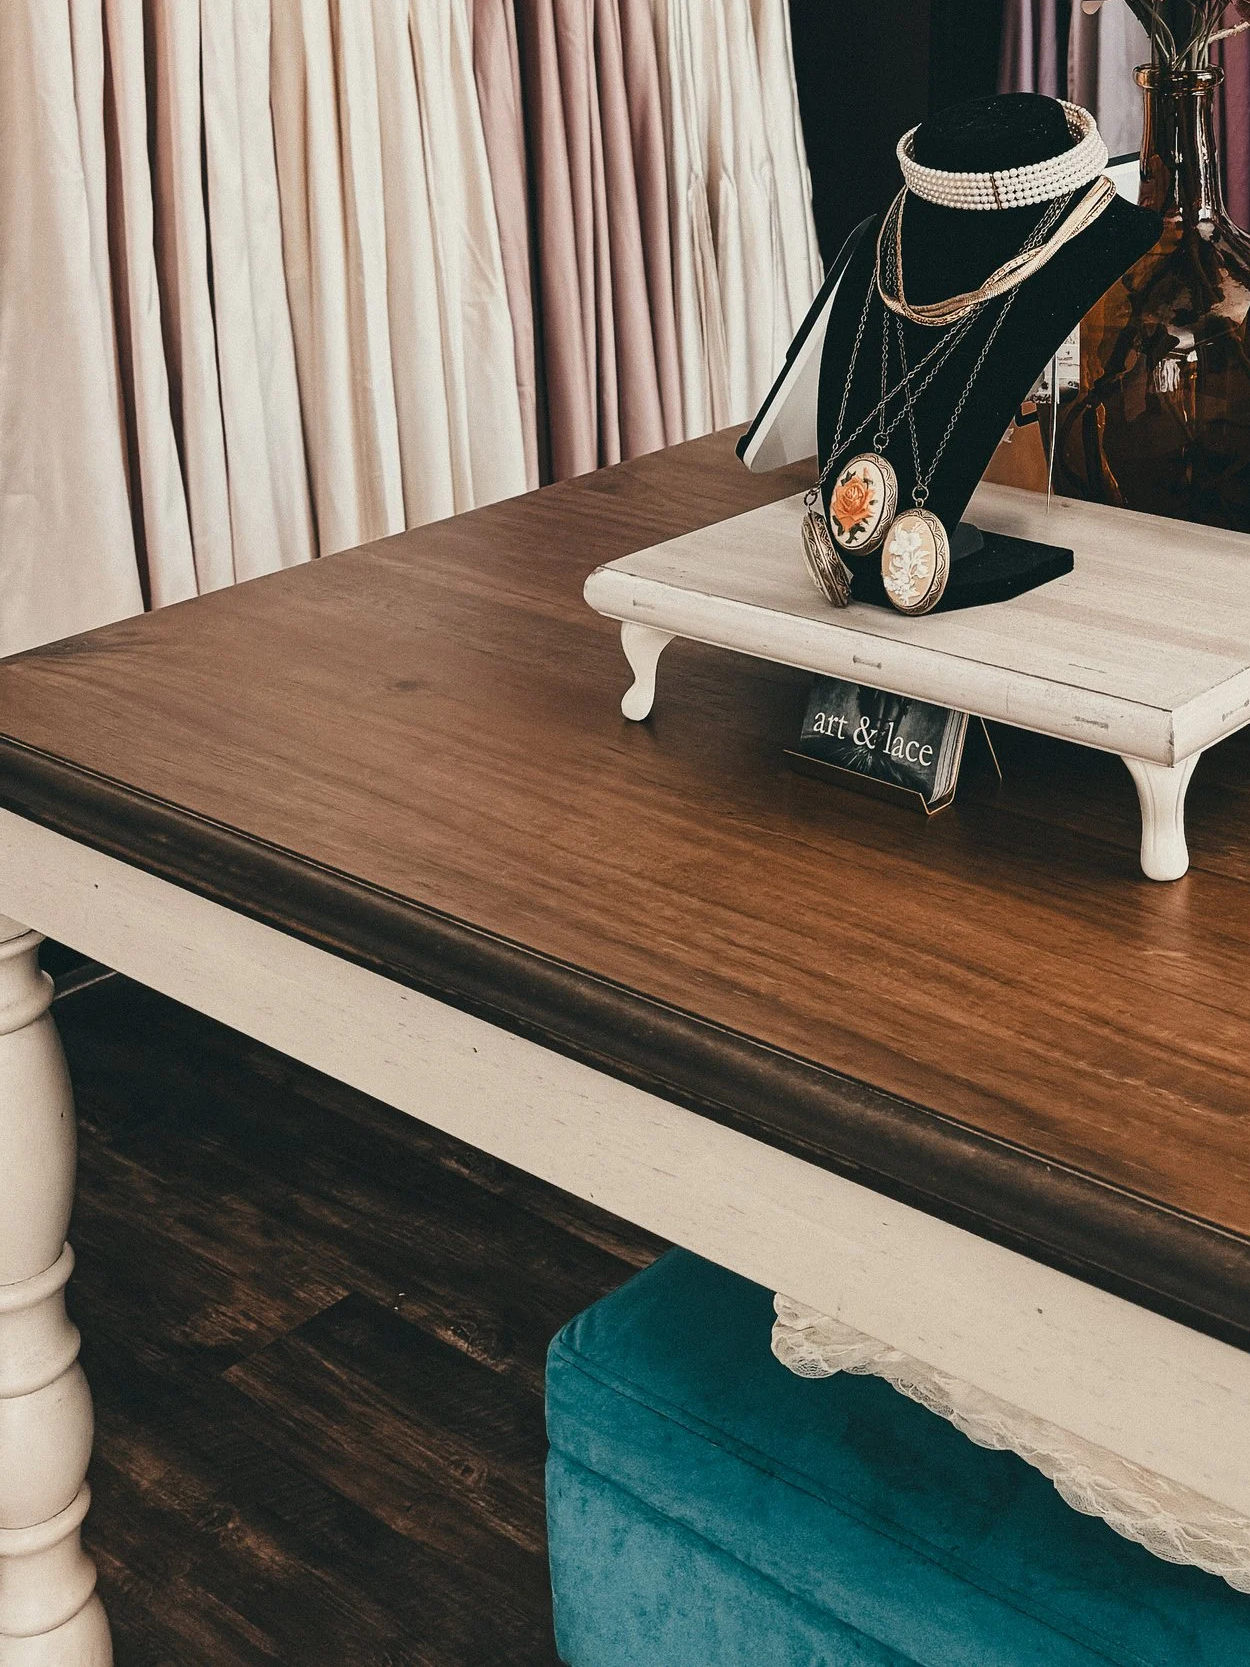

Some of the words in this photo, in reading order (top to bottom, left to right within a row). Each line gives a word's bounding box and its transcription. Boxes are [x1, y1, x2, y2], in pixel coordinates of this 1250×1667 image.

[813, 712, 848, 739] art
[853, 716, 878, 749] &
[883, 722, 933, 766] lace
